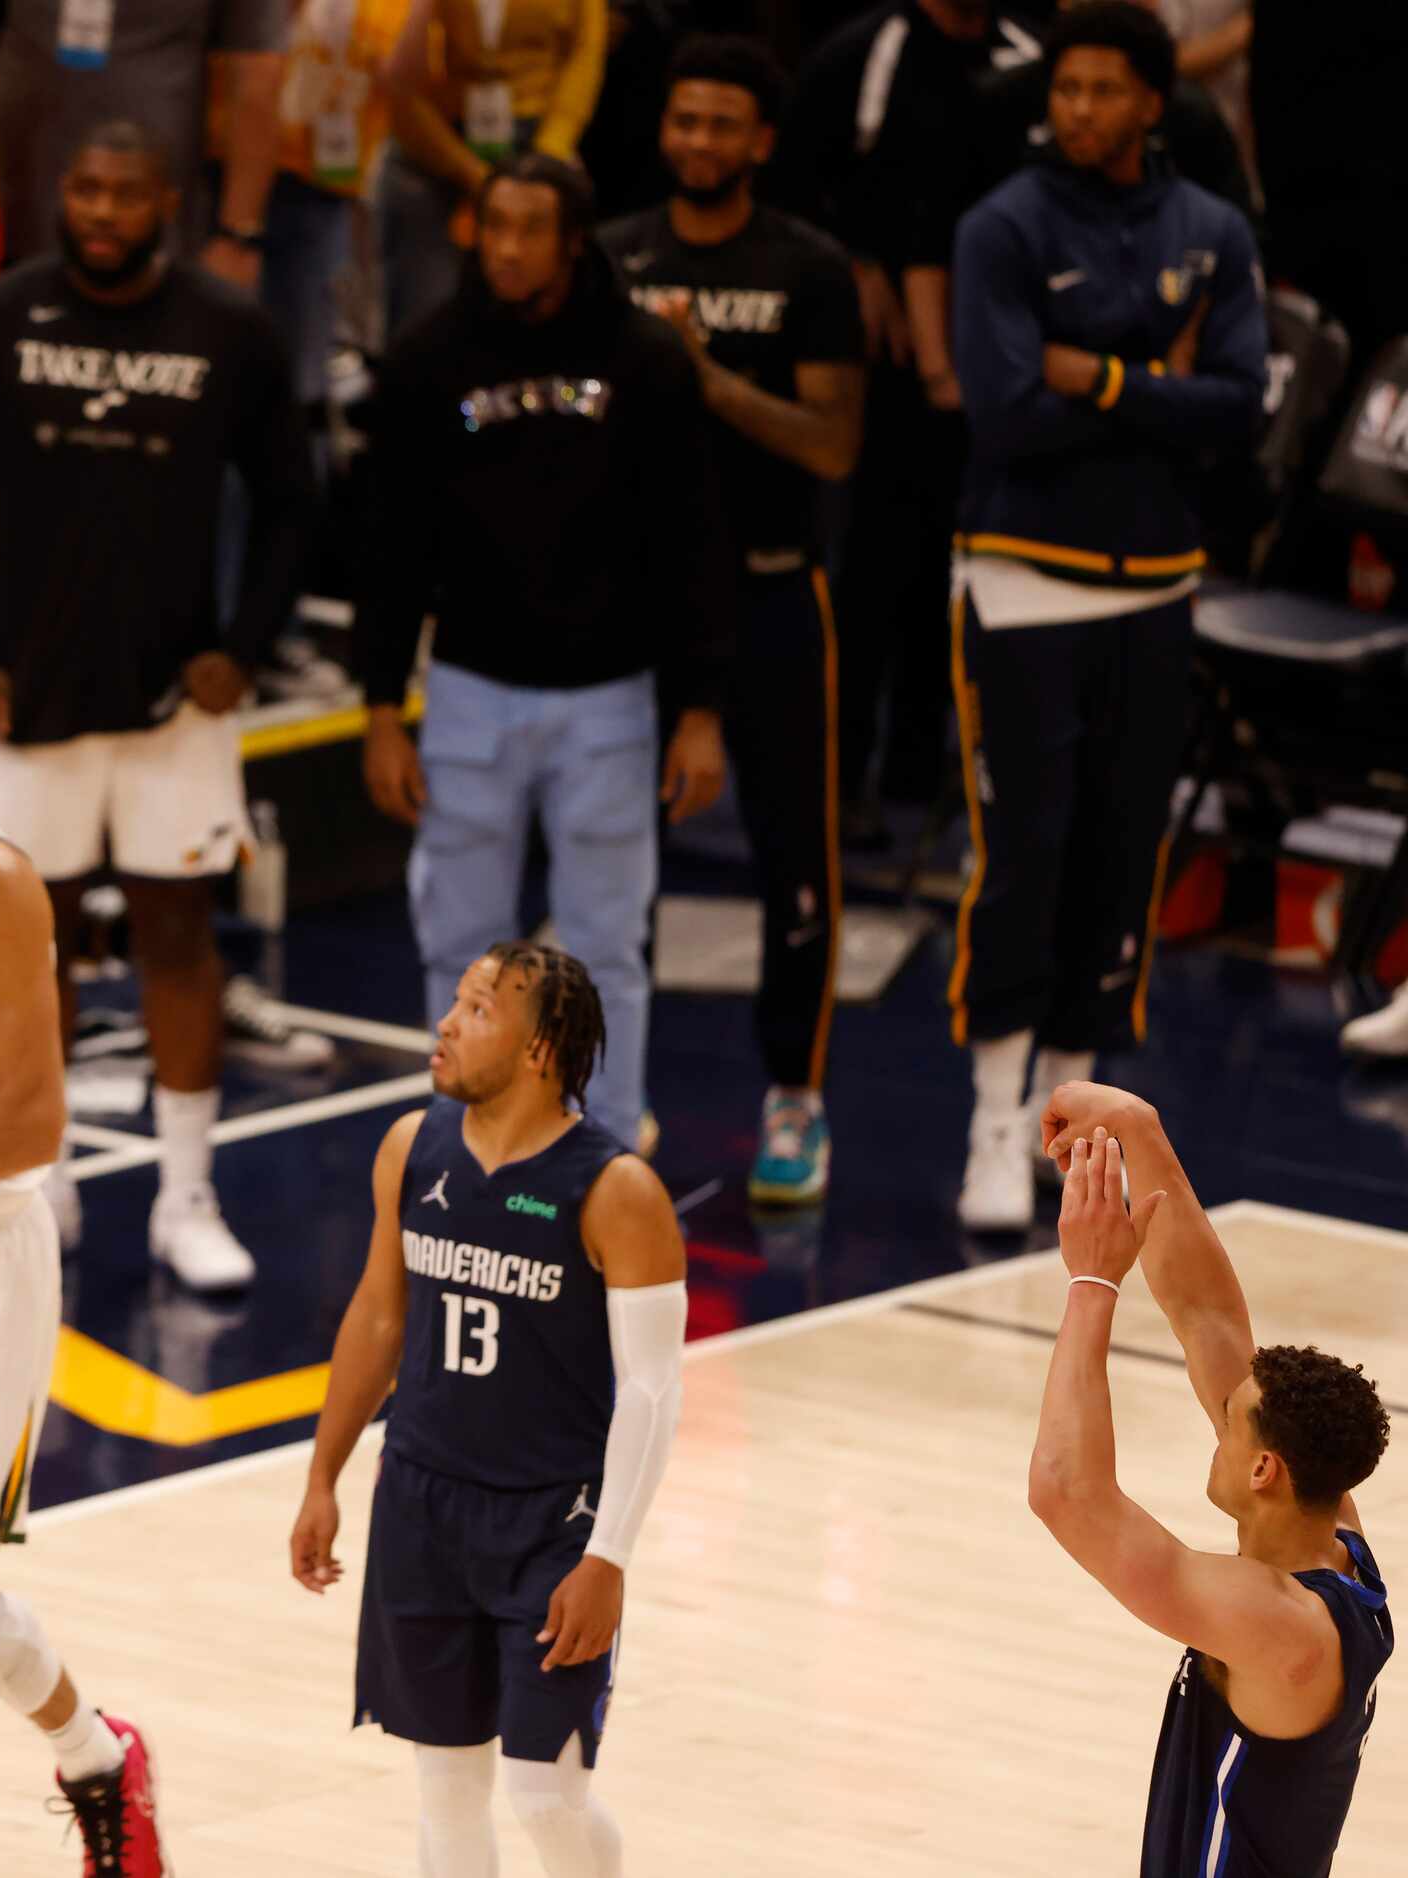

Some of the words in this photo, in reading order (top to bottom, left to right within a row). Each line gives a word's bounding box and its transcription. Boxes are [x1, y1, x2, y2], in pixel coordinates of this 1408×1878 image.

[15, 338, 114, 391] TAKE
[113, 351, 210, 400] NOTE
[505, 1192, 558, 1221] chime
[402, 1228, 564, 1302] MAVERICKS
[441, 1292, 500, 1377] 13
